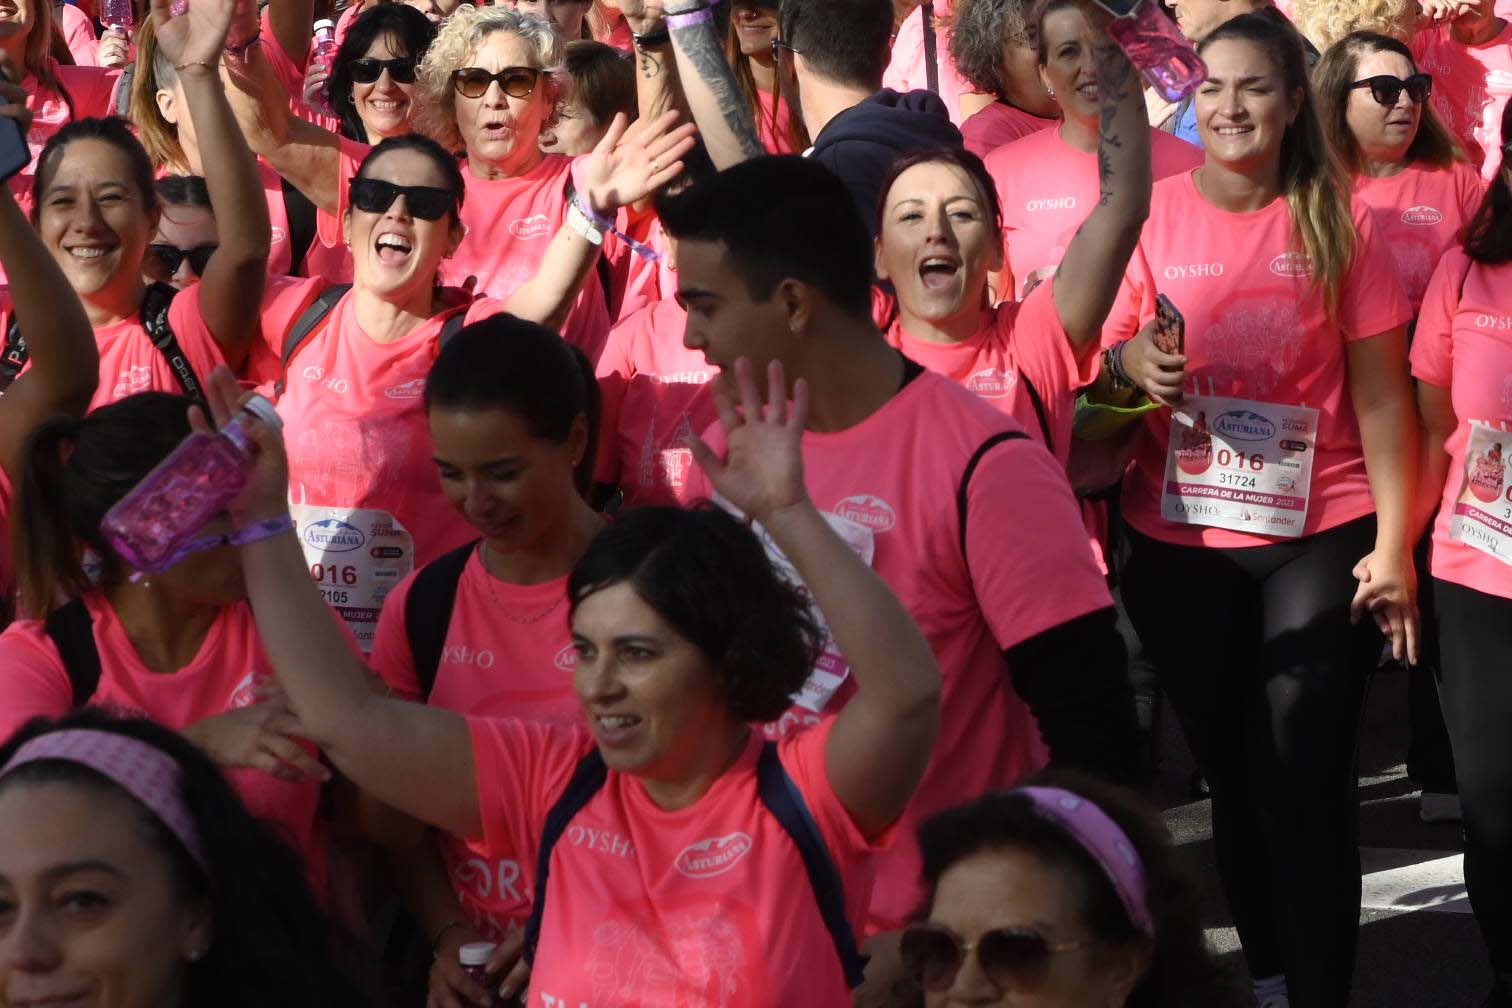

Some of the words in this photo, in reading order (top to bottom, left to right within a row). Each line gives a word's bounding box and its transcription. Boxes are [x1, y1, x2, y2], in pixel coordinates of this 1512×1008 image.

[1026, 196, 1076, 211] OYSHO
[1164, 262, 1224, 280] OYSHO
[1217, 420, 1271, 437] ASTURIANA
[1217, 449, 1264, 471] 016
[1219, 473, 1256, 488] 31724
[1181, 486, 1219, 497] CARRERA
[1220, 490, 1232, 499] DE
[1234, 492, 1244, 501] LA
[1245, 494, 1274, 504] MUJER
[1175, 503, 1219, 515] OYSHO
[1468, 509, 1502, 529] CARRERA
[308, 527, 360, 545] ASTURIANA
[311, 563, 357, 585] 016
